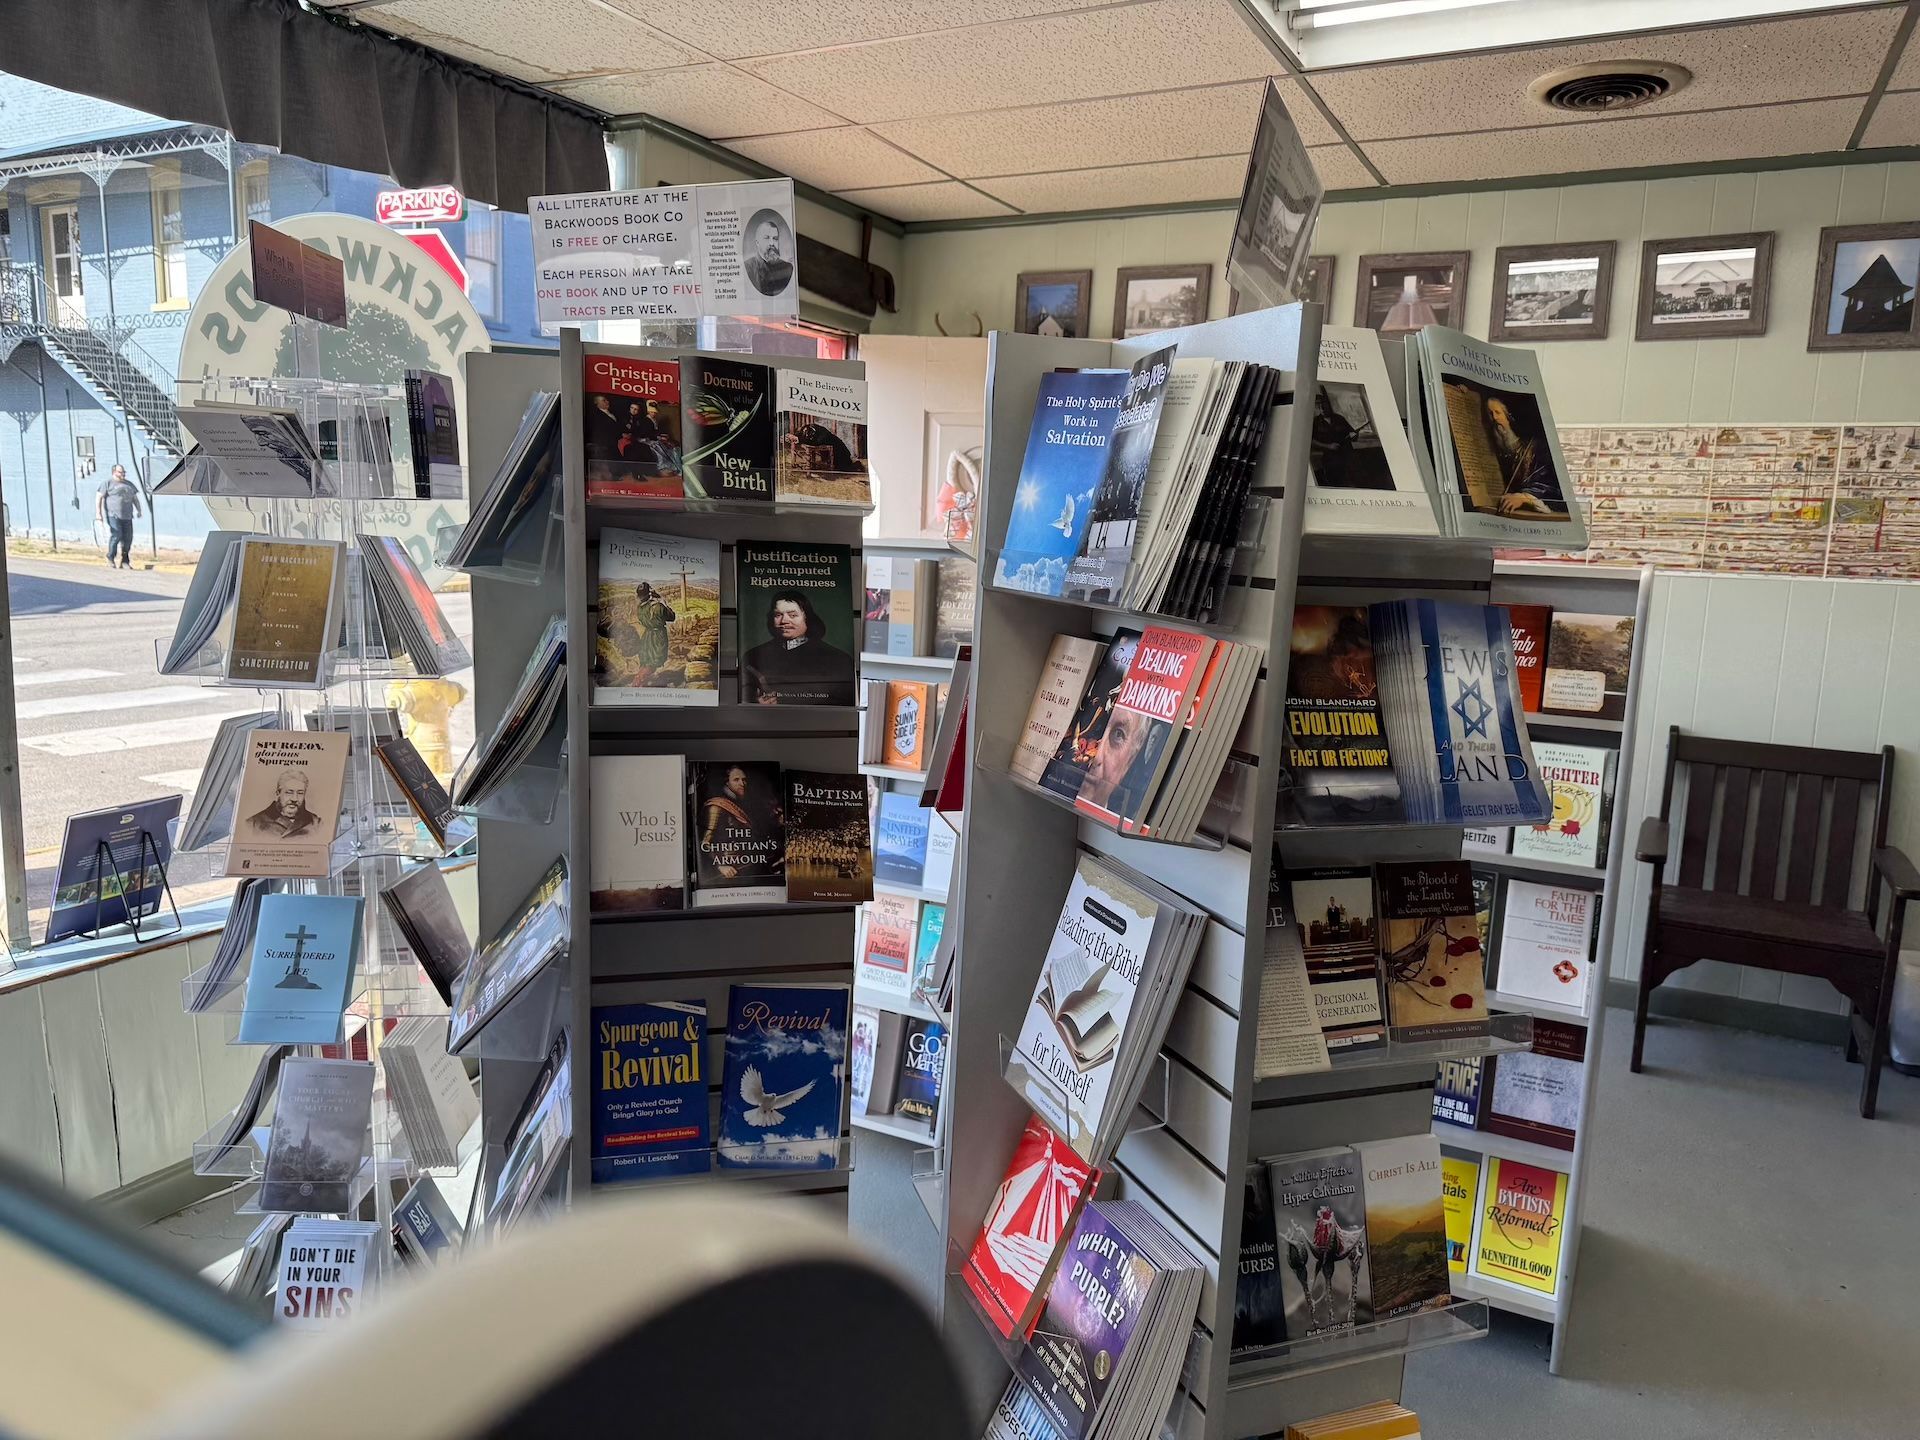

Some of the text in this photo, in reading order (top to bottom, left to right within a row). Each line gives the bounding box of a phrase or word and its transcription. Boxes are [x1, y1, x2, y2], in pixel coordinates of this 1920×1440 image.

[380, 190, 456, 210] PARKING
[537, 192, 689, 211] ALL LITERATURE AT THE
[544, 214, 619, 230] BACKWOODS
[624, 211, 660, 225] BOOK
[552, 233, 678, 248] IS FREE OF CHARGE.
[543, 265, 693, 281] EACH PERSON MAY TAKE
[537, 284, 702, 299] ONE BOOK AND UP TO FIVE
[562, 304, 677, 317] TRACTS PER WEEK.
[1461, 345, 1501, 368] THE TEN
[594, 362, 674, 384] Christian
[1328, 360, 1357, 371] FAITH
[1441, 352, 1530, 386] COMMANDMENTS
[611, 377, 657, 396] Fools
[704, 371, 754, 392] DOCTRINE
[797, 376, 854, 394] The Believer's
[788, 386, 862, 412] PARADOX
[1046, 394, 1122, 410] The Holy Spirit's
[1063, 415, 1098, 427] Work in
[1045, 429, 1105, 447] Salvation
[714, 451, 751, 472] New
[722, 470, 767, 492] Birth
[1308, 496, 1404, 509] BY DR. CECIL FAYARD,
[609, 543, 705, 566] Pilgrim's Progress
[744, 550, 839, 565] Justification
[754, 566, 765, 575] by
[781, 565, 831, 576] Imputed
[750, 577, 836, 588] Righteousness
[1142, 631, 1202, 653] JOHN BLANCHARD
[240, 657, 309, 671] SANCTIFICATION
[1138, 646, 1187, 678] DEALING
[1421, 644, 1510, 680] JEWS
[1146, 673, 1165, 685] WITH
[1040, 690, 1059, 705] GLOBAL
[1120, 678, 1181, 717] DAWKINS
[1285, 697, 1313, 706] JOHN
[1316, 698, 1376, 707] BLANCHARD
[895, 709, 918, 727] SUNNY
[1290, 711, 1379, 736] EVOLUTION
[894, 723, 918, 739] SIDE UP
[1028, 720, 1061, 740] CHRISTIANITY
[255, 749, 299, 758] glorious
[1290, 749, 1388, 767] FACT OR FICTION?
[258, 757, 309, 767] Spurgeon
[1436, 752, 1529, 785] LAND
[1538, 766, 1600, 787] AUGHTER
[793, 783, 863, 800] BAPTISM
[618, 811, 676, 826] Who Is
[1488, 804, 1504, 817] RAY
[633, 826, 677, 847] Jesus?
[726, 828, 752, 838] THE
[887, 822, 921, 836] UNITED
[700, 839, 778, 853] CHRISTIAN'S
[886, 834, 919, 848] PRAYER
[1463, 831, 1497, 845] HEITZIG
[712, 855, 767, 866] ARMOUR
[1402, 870, 1458, 886] The Blood of
[1421, 887, 1455, 902] Lamb:
[1552, 890, 1587, 905] FAITH
[1405, 902, 1469, 916] Conquering Weapon
[1535, 898, 1585, 915] FOR THE
[1550, 910, 1585, 924] TIMES
[1058, 905, 1098, 953] Reading
[1093, 930, 1114, 964] the
[1111, 941, 1142, 986] Bible
[1554, 947, 1581, 955] REDPATH
[264, 949, 335, 961] SURRENDERED
[285, 965, 310, 976] LIFE
[1315, 992, 1368, 1006] DECISIONAL
[737, 1001, 832, 1035] Revival
[1316, 1002, 1377, 1020] EGENERATION
[600, 1015, 699, 1049] Spurgeon &
[600, 1043, 701, 1091] Revival
[1031, 1032, 1094, 1105] for Yourself
[607, 1097, 683, 1113] Only Revived Church
[612, 1106, 679, 1120] Brings Glory God
[1453, 1111, 1475, 1125] WORLD
[614, 1157, 637, 1166] Robert
[1369, 1166, 1404, 1182] CHRIST
[1508, 1177, 1543, 1195] Are
[1282, 1183, 1356, 1208] Hyper-Calvinism
[1498, 1188, 1552, 1216] BAPTISTS
[1487, 1206, 1560, 1246] Reformed?
[290, 1247, 356, 1263] DON'T DIE
[1481, 1247, 1552, 1277] KENNETH H. GOOD
[287, 1267, 341, 1282] IN YOUR
[1076, 1232, 1138, 1303] WHAT TIME
[1101, 1266, 1110, 1281] IS
[284, 1286, 353, 1318] SINS
[1070, 1260, 1126, 1330] PURPLE?
[1031, 1375, 1043, 1393] TOM
[1042, 1390, 1068, 1427] HAMMOND
[1073, 1388, 1087, 1413] TRUTH
